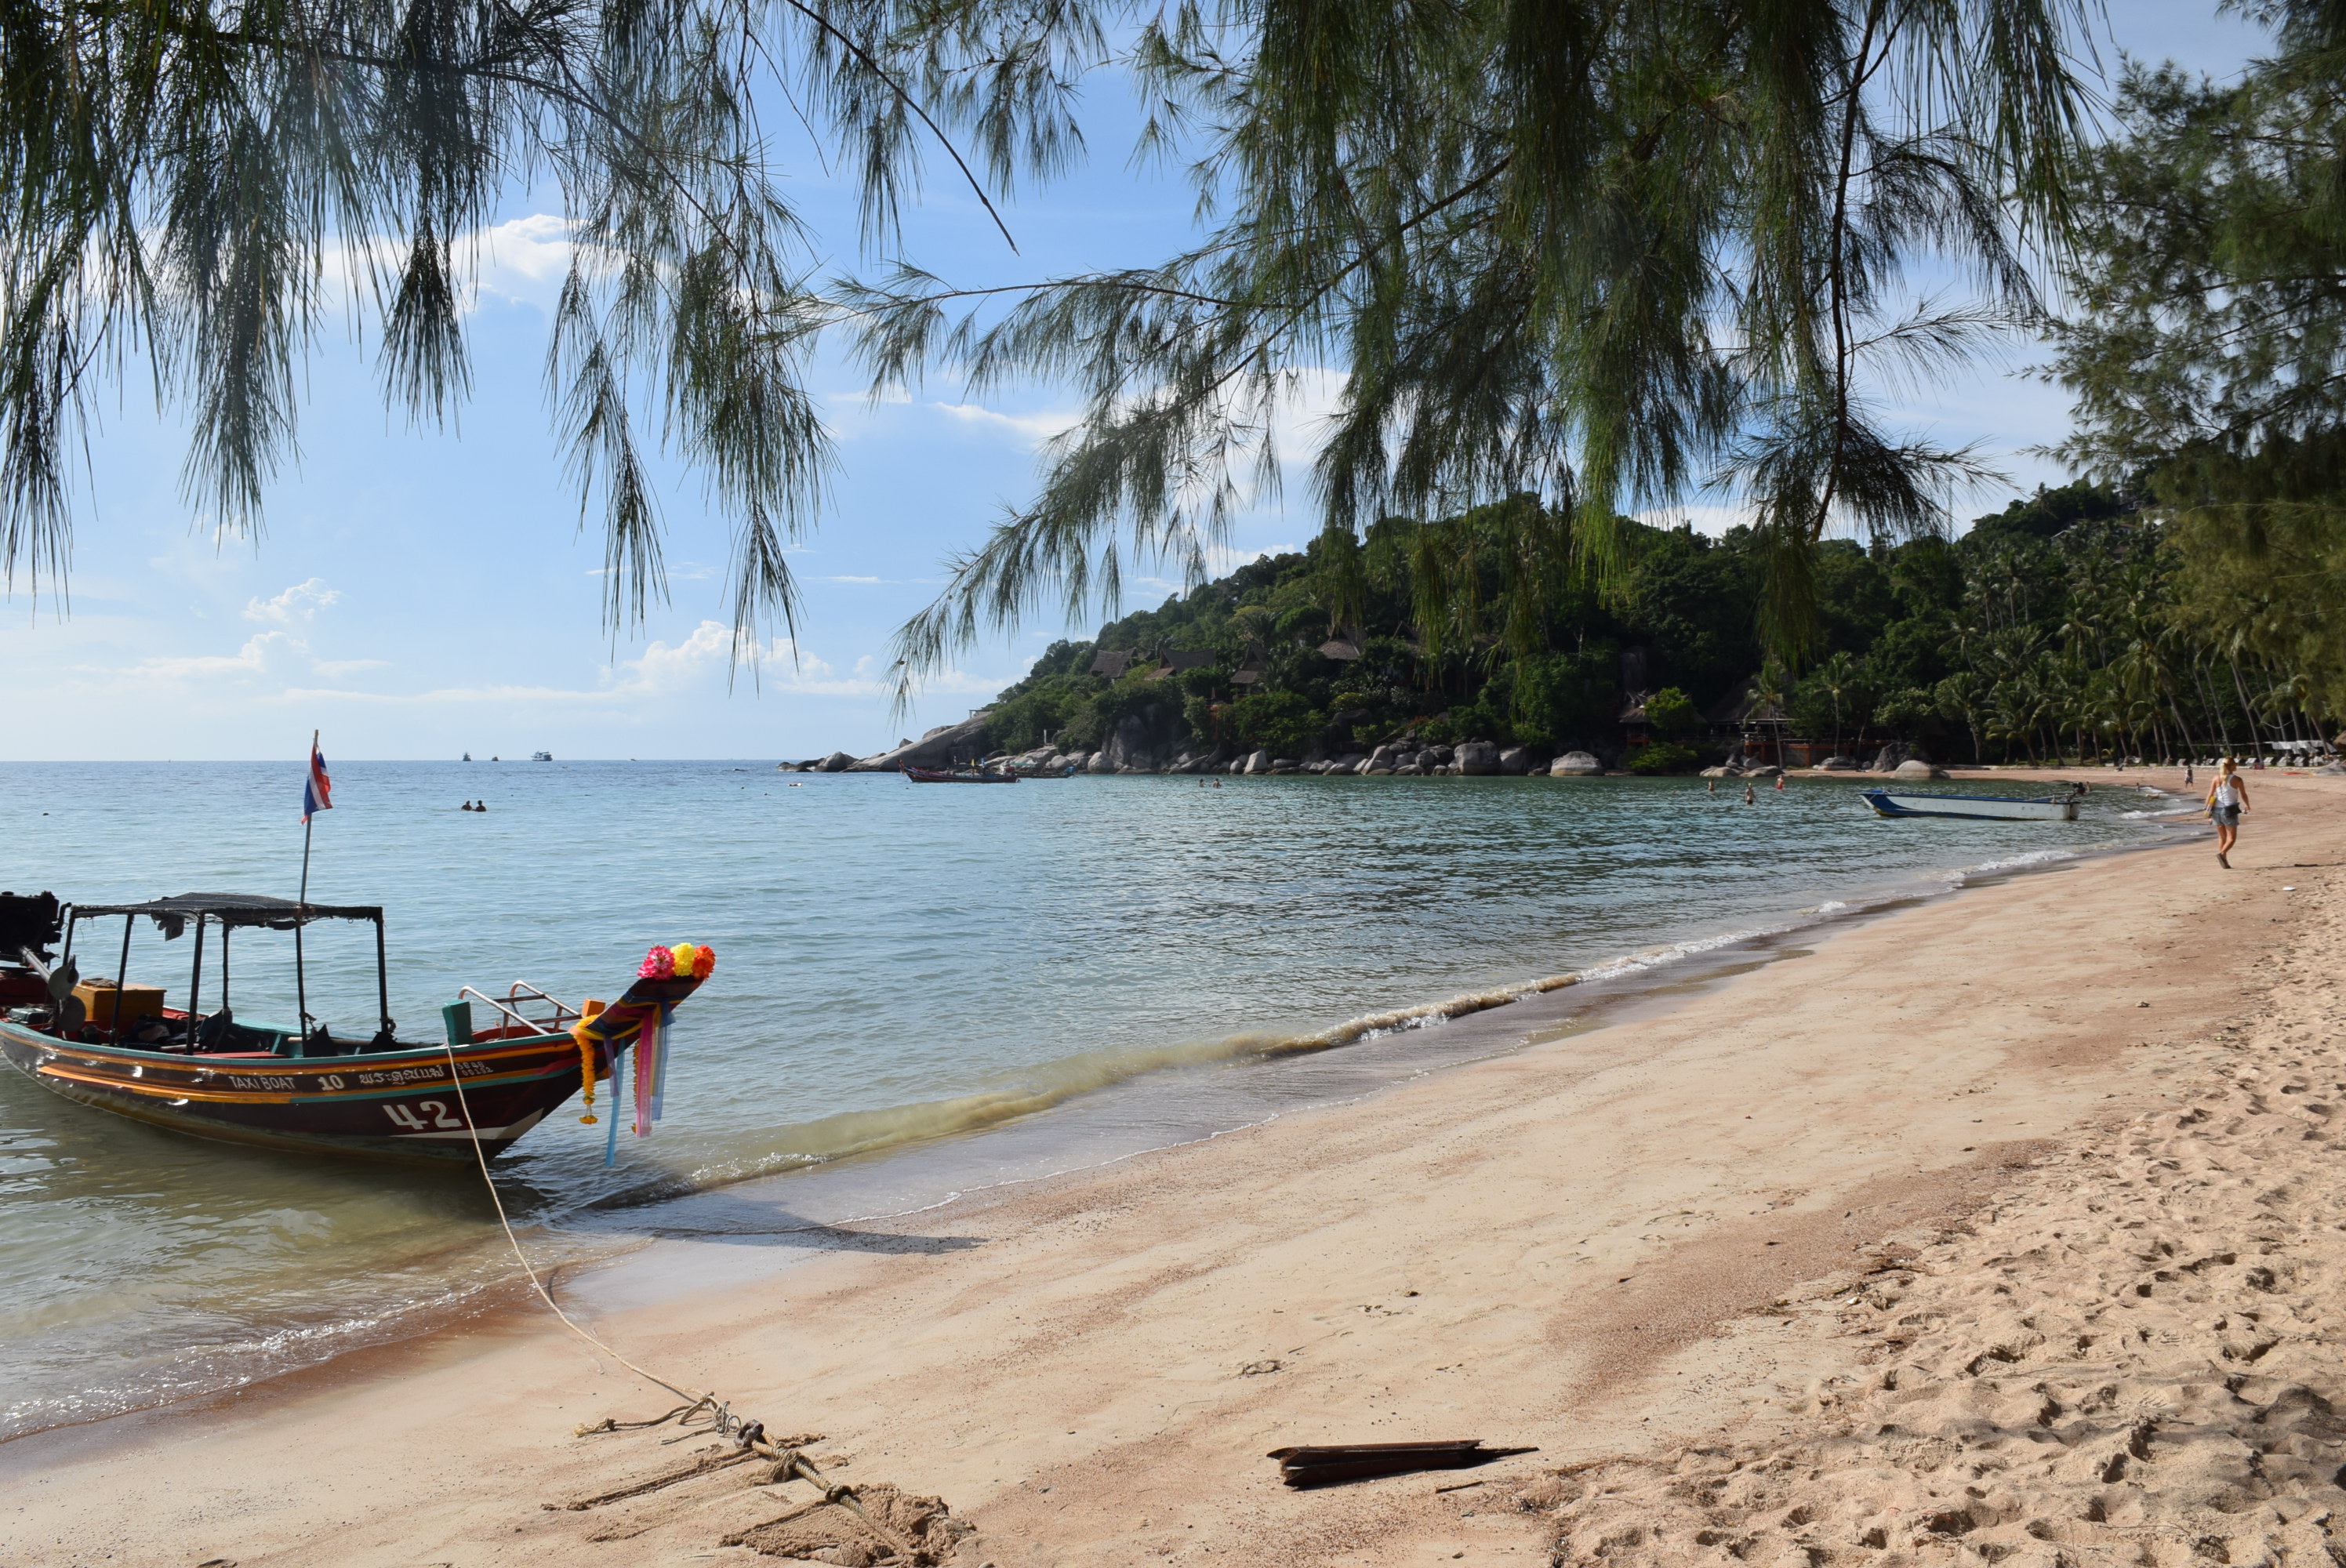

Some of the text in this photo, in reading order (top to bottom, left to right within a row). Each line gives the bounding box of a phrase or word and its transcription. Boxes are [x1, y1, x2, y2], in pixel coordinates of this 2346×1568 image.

[228, 1076, 296, 1091] TAXI BOAT
[318, 1074, 345, 1091] 10
[382, 1101, 463, 1130] 42
